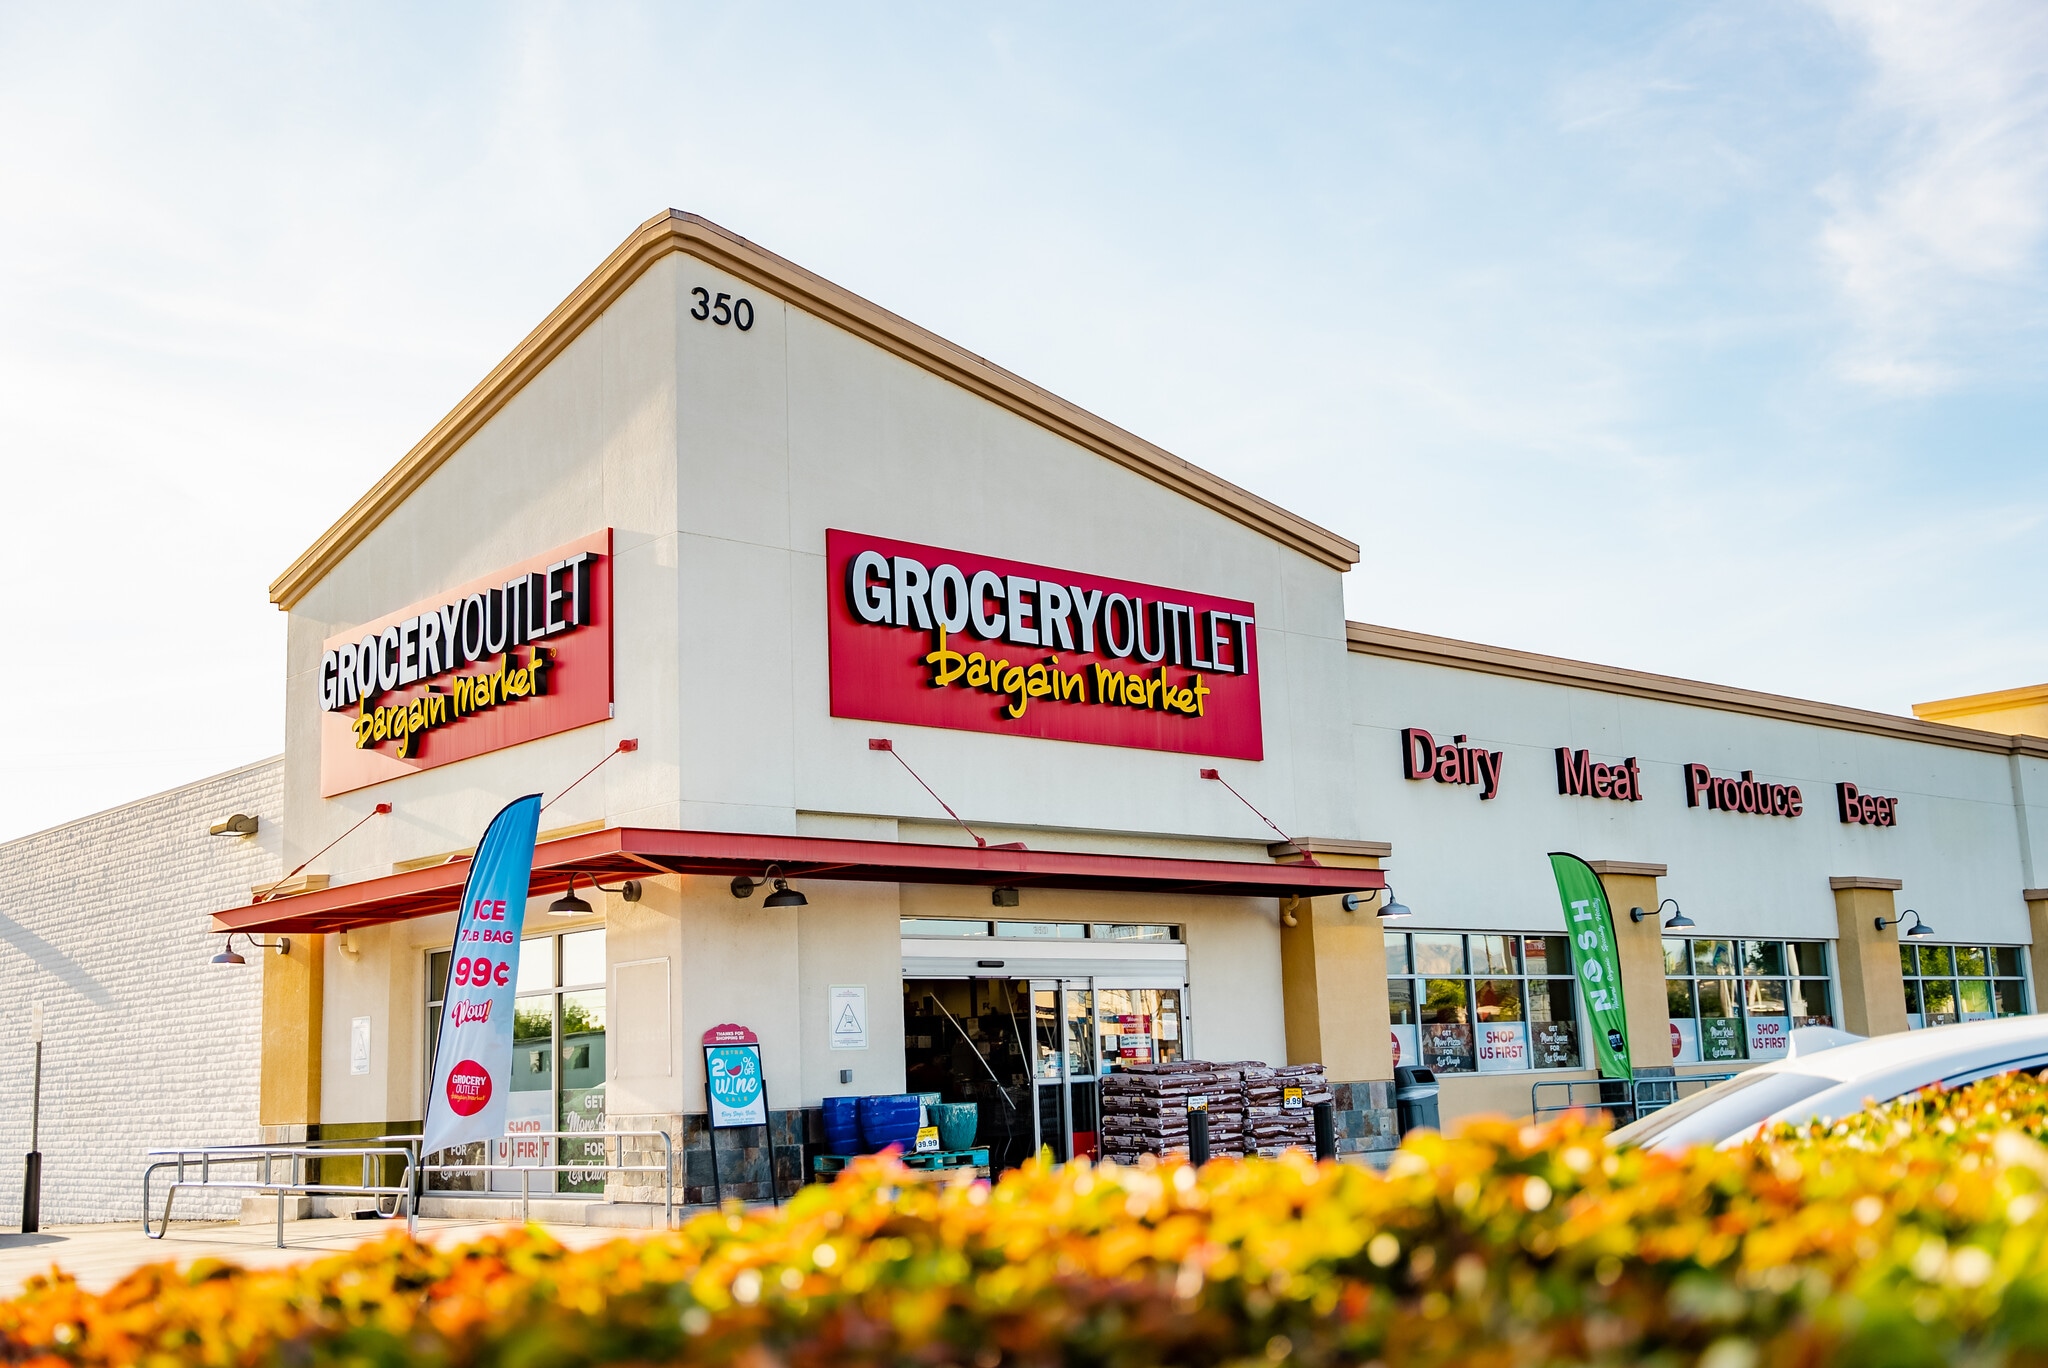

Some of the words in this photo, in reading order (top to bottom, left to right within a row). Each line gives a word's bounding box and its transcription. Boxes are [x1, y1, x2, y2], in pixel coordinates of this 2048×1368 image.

[690, 286, 754, 331] 350
[926, 623, 1084, 719] bargain
[1094, 662, 1210, 716] market
[352, 684, 447, 758] bargain
[453, 646, 543, 718] market
[1403, 728, 1502, 800] Dairy
[1555, 747, 1642, 801] Meat
[1685, 763, 1803, 817] Produce
[1837, 782, 1898, 826] Beer
[473, 899, 506, 921] ICE
[483, 929, 514, 944] BAG
[455, 957, 510, 987] 99¢
[1757, 1023, 1780, 1035] SHOP
[1486, 1030, 1515, 1044] SHOP
[1752, 1038, 1763, 1049] US
[1765, 1036, 1786, 1049] FIRST
[1480, 1047, 1494, 1059] US
[1495, 1045, 1523, 1059] FIRST
[452, 1074, 487, 1086] GROCERY
[455, 1084, 480, 1095] OUTLET
[585, 1095, 604, 1109] GET
[1286, 1097, 1302, 1105] 9.99
[451, 1145, 467, 1156] FOR
[584, 1142, 605, 1156] FOR
[918, 1140, 938, 1148] 39.99
